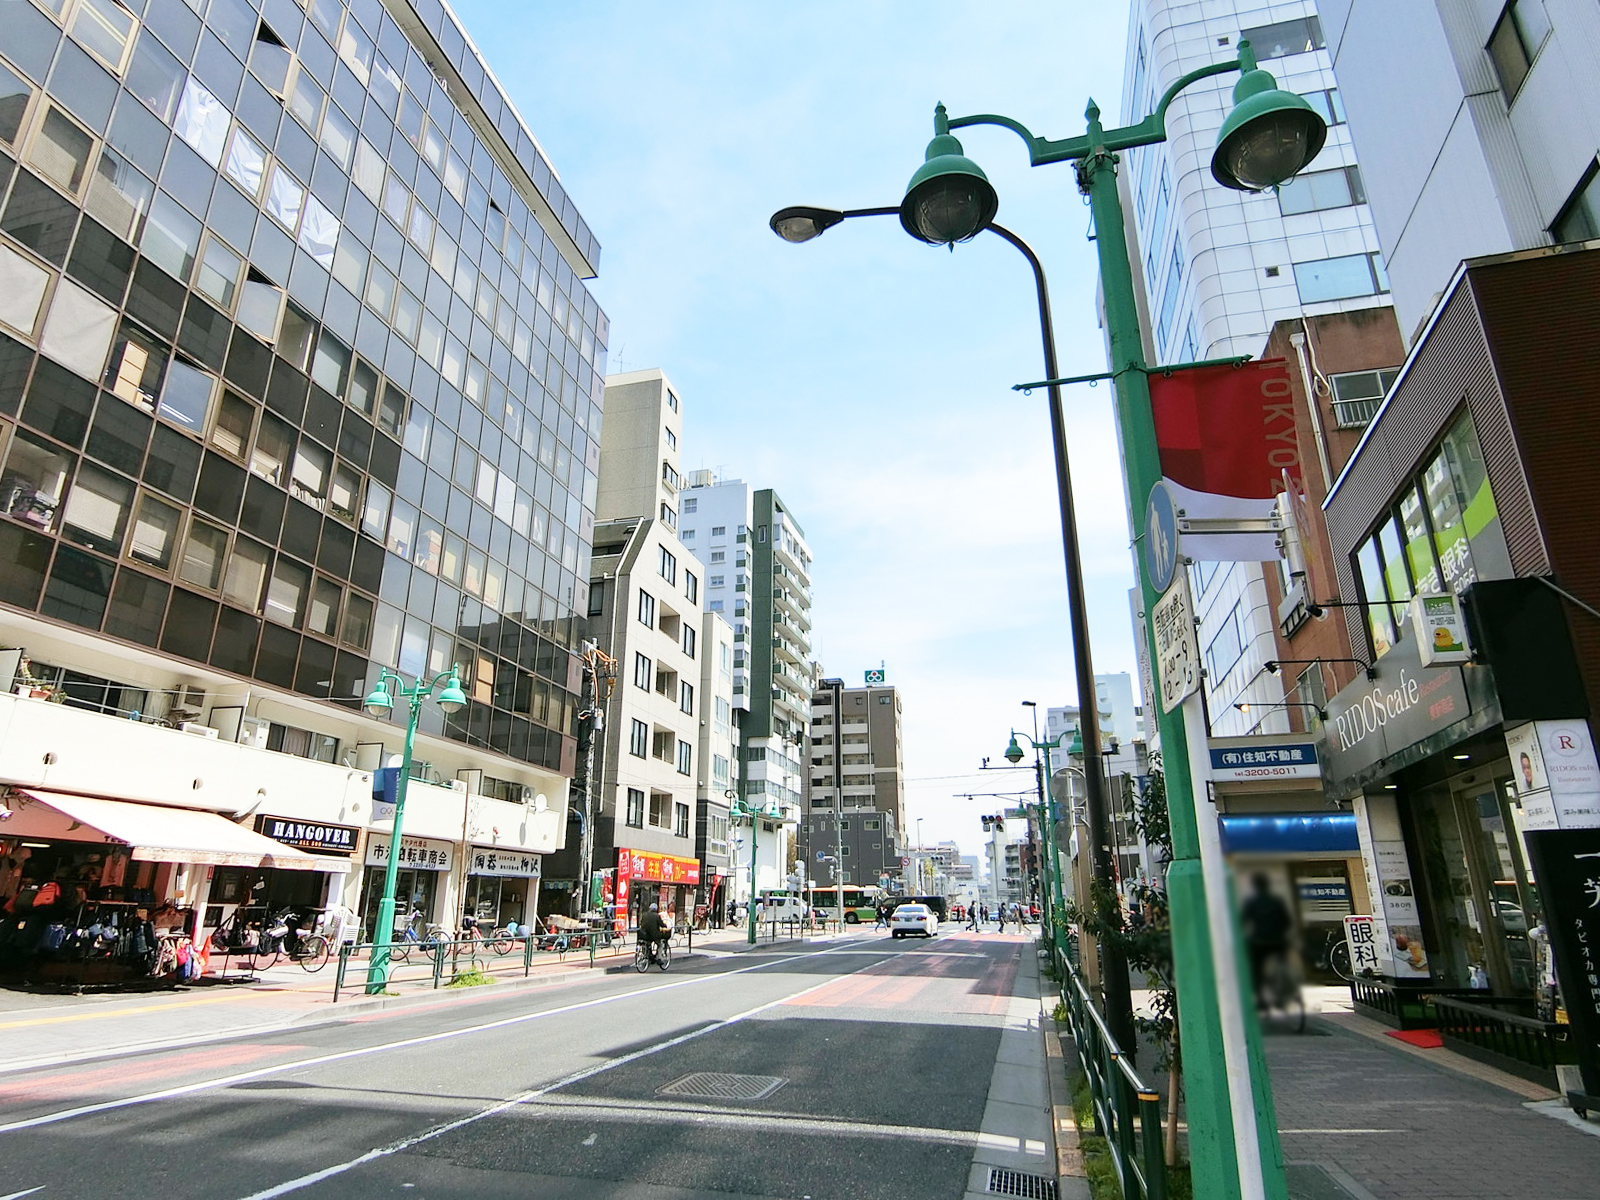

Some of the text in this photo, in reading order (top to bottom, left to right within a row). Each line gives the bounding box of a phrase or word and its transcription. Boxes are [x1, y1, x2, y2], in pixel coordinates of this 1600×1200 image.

[1259, 361, 1299, 467] TOKYO
[1558, 735, 1575, 749] R
[1221, 749, 1303, 764] (有)住知不動産
[273, 821, 351, 844] HANGOVER
[1350, 923, 1378, 967] 眼科
